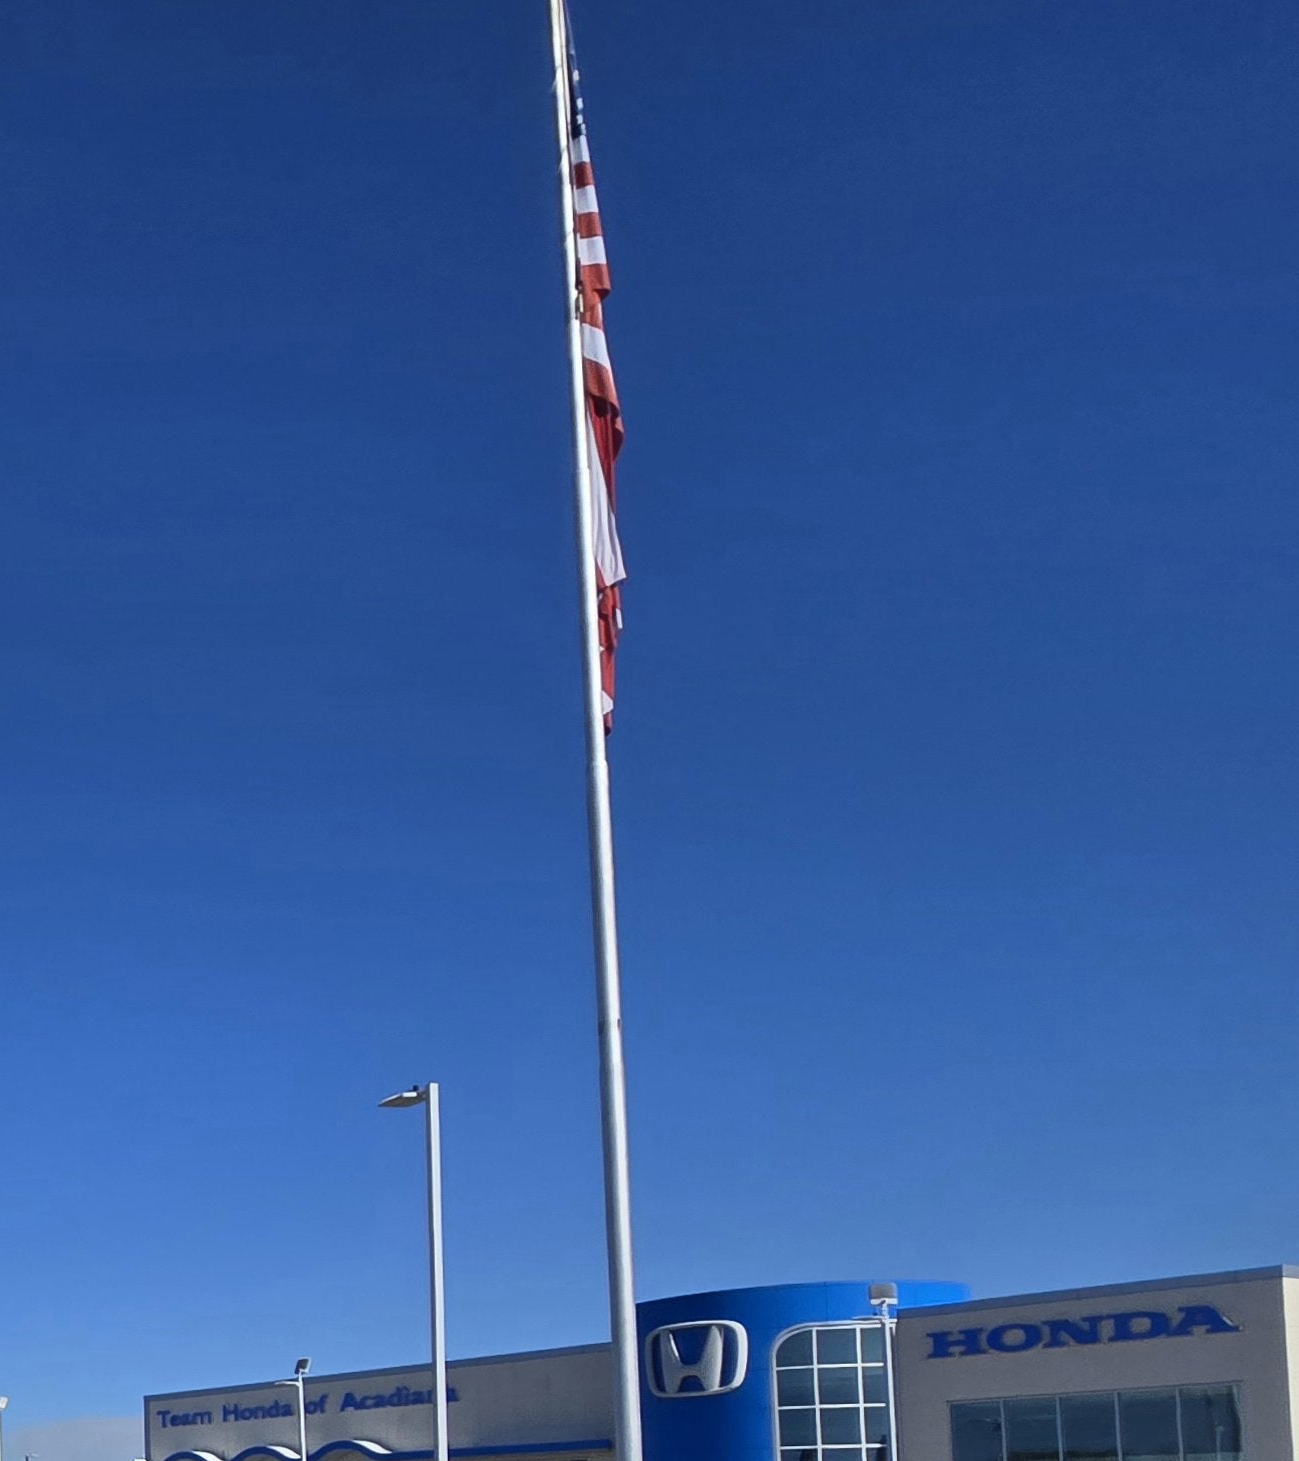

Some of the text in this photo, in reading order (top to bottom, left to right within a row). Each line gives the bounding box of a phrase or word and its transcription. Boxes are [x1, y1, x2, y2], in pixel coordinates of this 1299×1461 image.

[926, 1304, 1241, 1359] HONDA
[156, 1409, 213, 1428] Team
[222, 1399, 294, 1422] Honda
[304, 1393, 329, 1415] of
